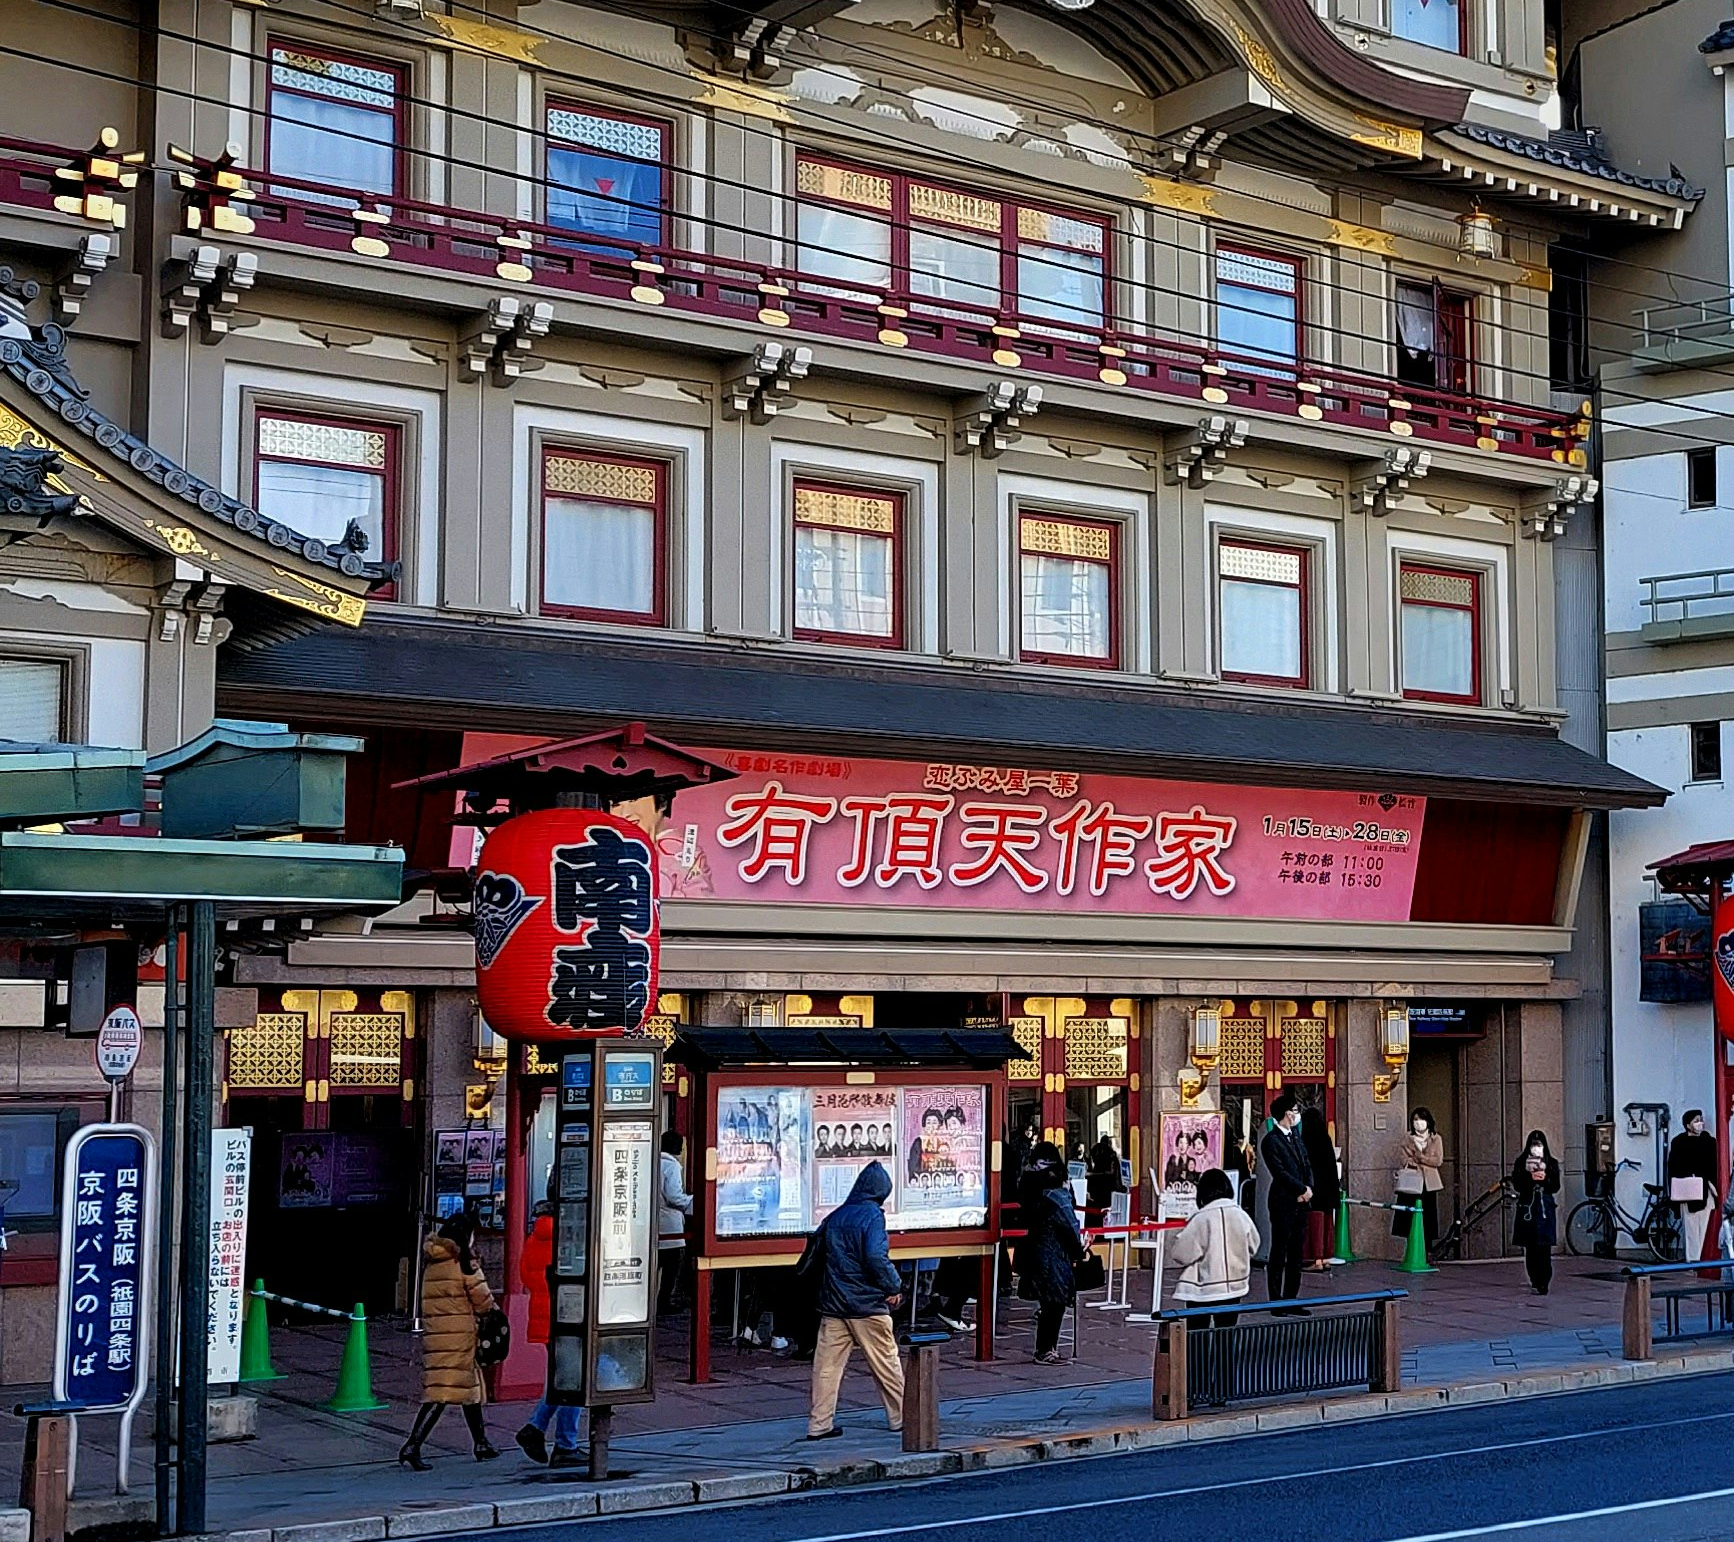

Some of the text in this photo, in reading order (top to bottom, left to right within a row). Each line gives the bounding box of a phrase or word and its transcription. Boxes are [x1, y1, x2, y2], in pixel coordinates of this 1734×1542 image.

[924, 763, 1080, 798] 恋ぶみ屋一葉
[717, 780, 1238, 901] 有頂天作家
[1280, 851, 1384, 870] 午前の部 11:00
[1277, 869, 1331, 885] 午後の部
[612, 1089, 623, 1102] B
[72, 1170, 106, 1378] 京阪バスのりば
